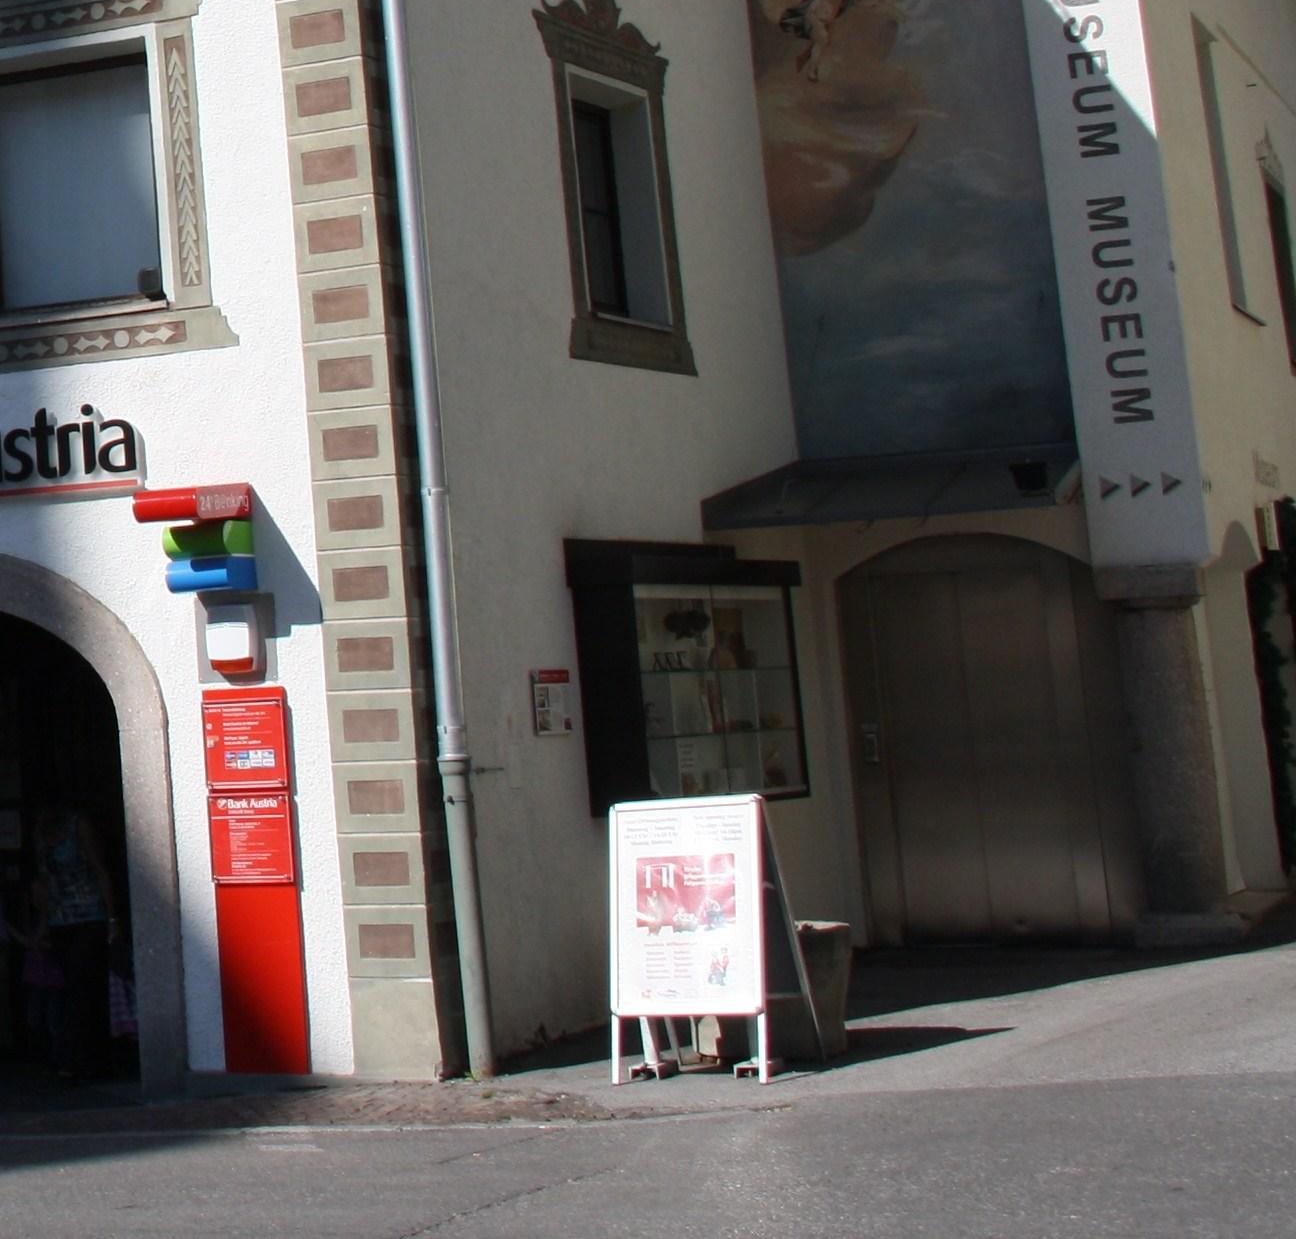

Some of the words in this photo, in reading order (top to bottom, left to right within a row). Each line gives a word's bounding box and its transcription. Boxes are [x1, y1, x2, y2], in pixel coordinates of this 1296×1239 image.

[1085, 194, 1155, 425] MUSEUM
[228, 798, 249, 809] Bank
[250, 797, 278, 809] Austria
